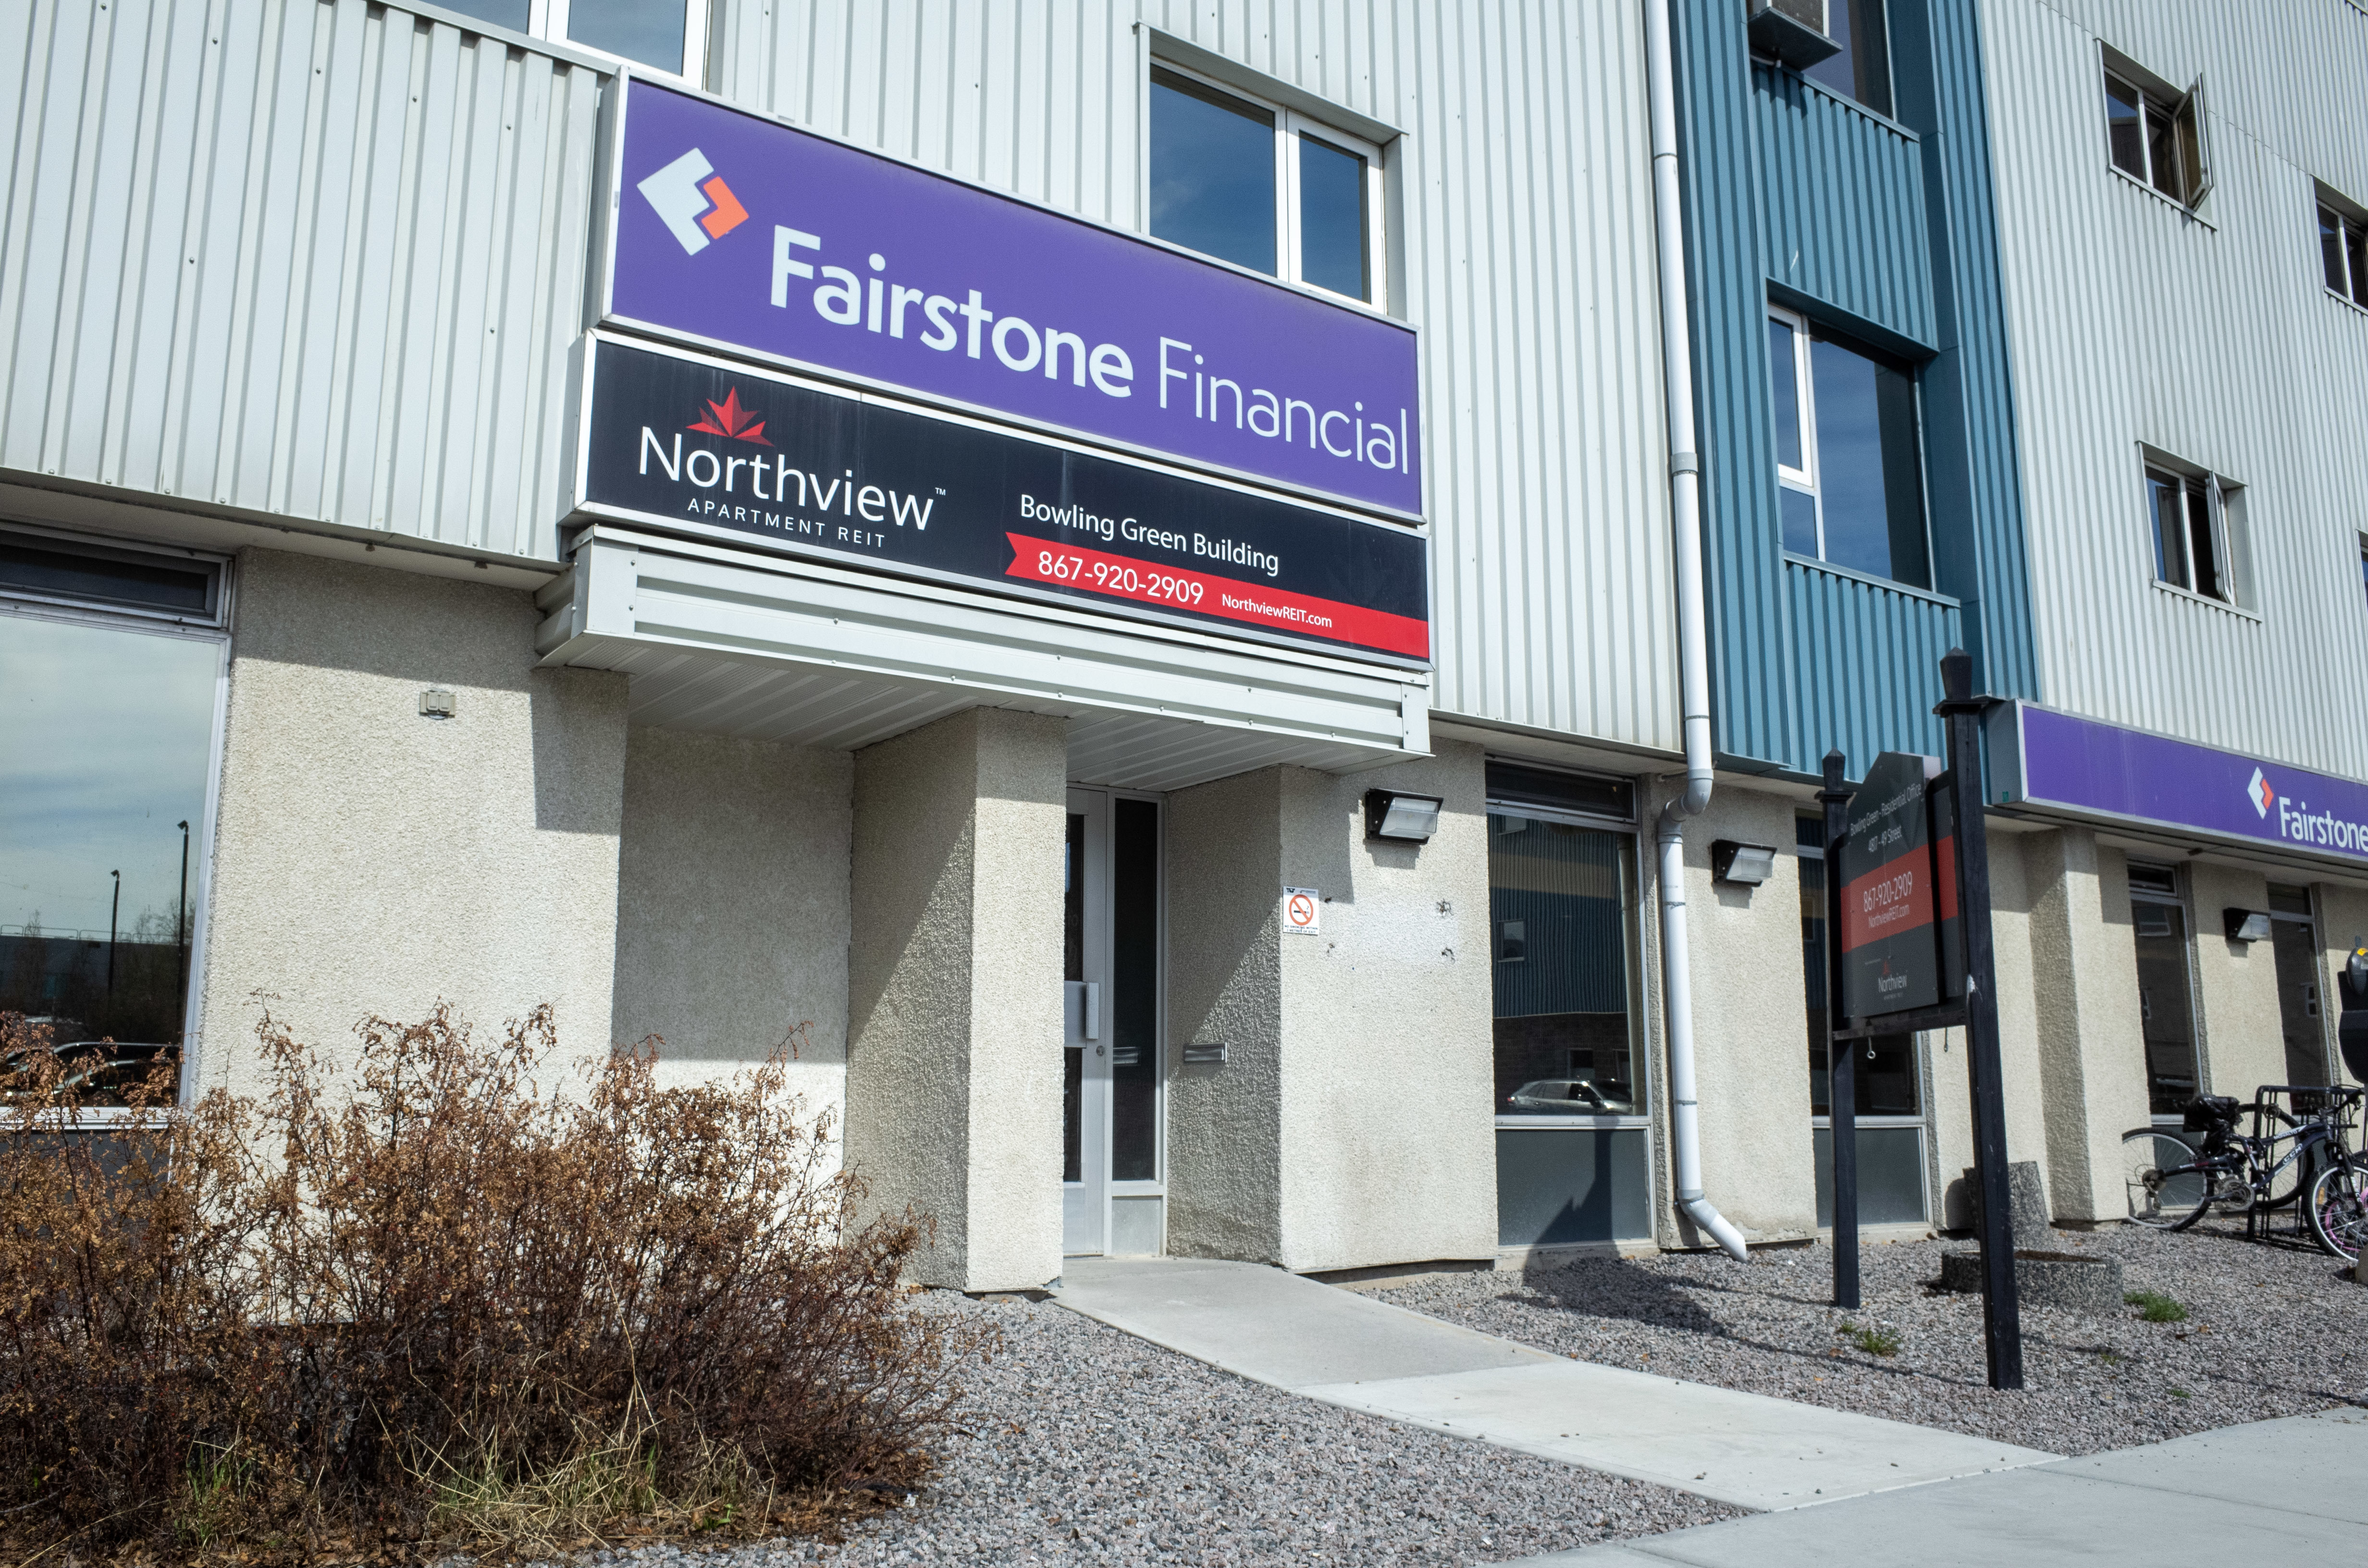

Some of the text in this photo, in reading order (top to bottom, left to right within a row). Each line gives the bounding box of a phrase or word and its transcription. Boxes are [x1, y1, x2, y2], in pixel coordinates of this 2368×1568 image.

[771, 224, 1408, 474] Fairstone Financial
[640, 427, 934, 530] Northview
[688, 498, 885, 547] APARTMENT REIT
[1021, 494, 1279, 576] Bowling Green Building
[1038, 551, 1332, 628] 867-920-2909 NorthviewREIT.com
[1887, 825, 1902, 843] Street
[2279, 796, 2368, 852] Fairstone
[1863, 871, 1912, 912] 867-920-2909
[1878, 973, 1907, 992] Northview
[2283, 1146, 2302, 1163] CCM
